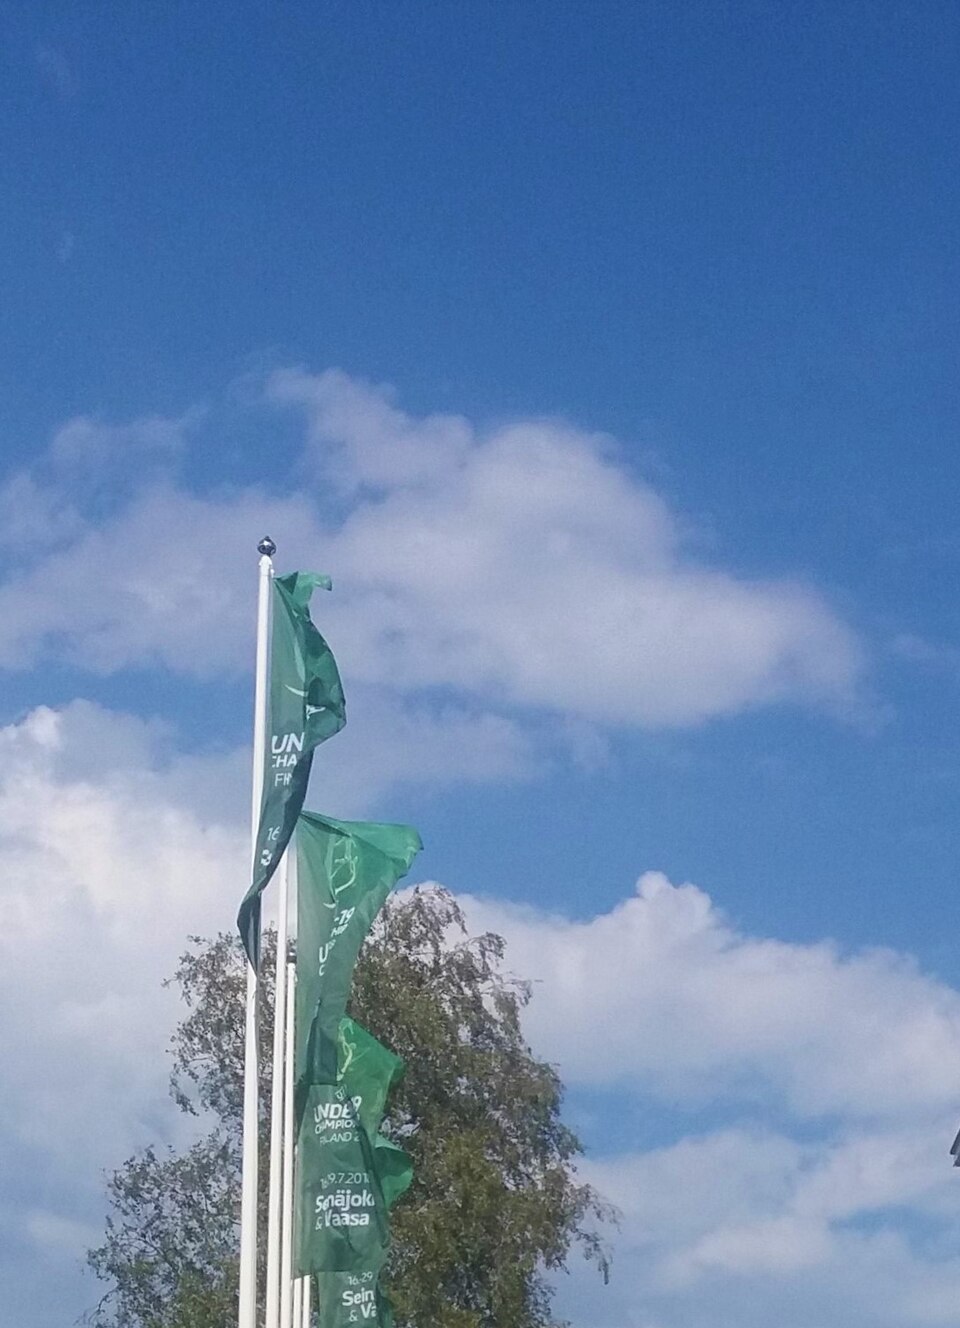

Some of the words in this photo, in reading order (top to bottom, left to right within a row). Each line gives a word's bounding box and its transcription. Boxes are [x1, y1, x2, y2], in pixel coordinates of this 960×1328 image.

[324, 1208, 370, 1227] Vaasa
[342, 1287, 374, 1307] Sein
[349, 1310, 358, 1322] &
